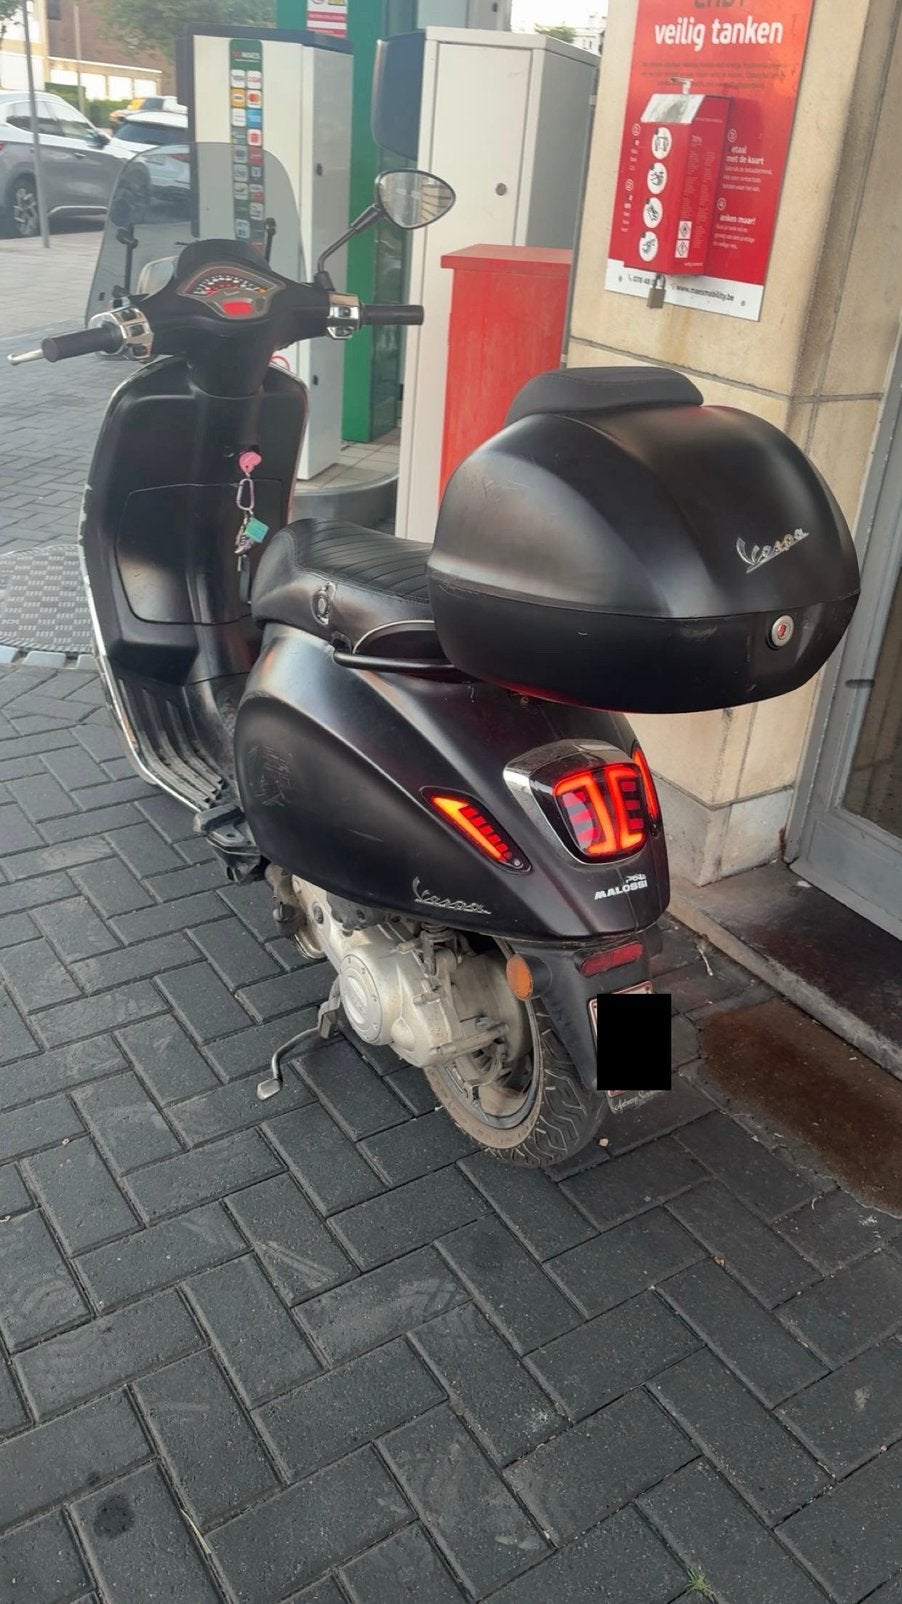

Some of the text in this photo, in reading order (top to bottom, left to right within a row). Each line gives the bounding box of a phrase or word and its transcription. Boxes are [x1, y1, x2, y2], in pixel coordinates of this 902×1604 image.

[655, 16, 783, 52] veilig tanken
[731, 145, 747, 154] etaal
[719, 214, 737, 223] anken
[736, 528, 810, 574] Vespa
[412, 876, 492, 915] Vespa
[594, 879, 648, 900] MALOSSI
